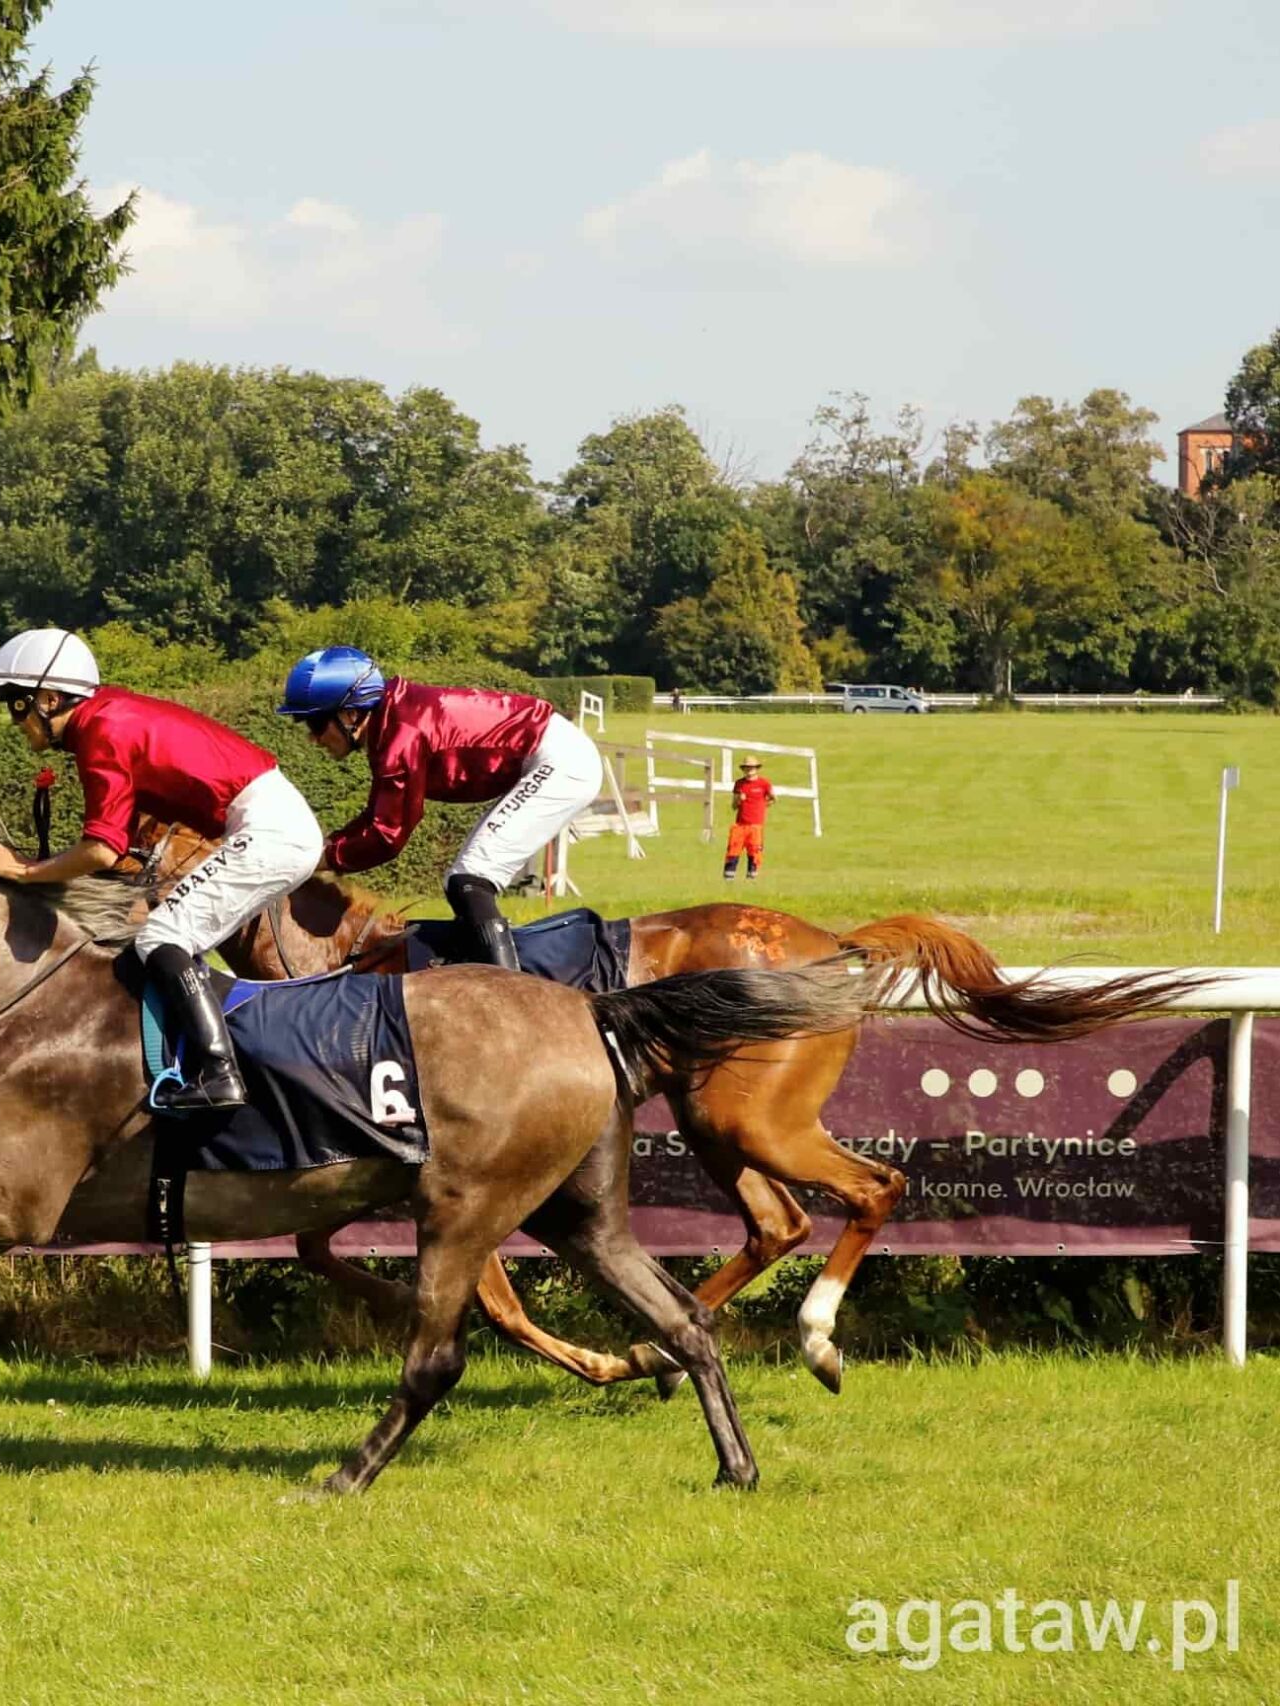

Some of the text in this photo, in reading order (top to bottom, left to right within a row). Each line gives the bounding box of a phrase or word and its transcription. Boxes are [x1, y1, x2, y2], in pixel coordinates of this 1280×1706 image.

[165, 851, 228, 912] ABAEV
[370, 1060, 417, 1125] 6
[966, 1130, 1137, 1163] Partynice
[921, 1178, 1008, 1198] konne.
[1016, 1177, 1135, 1198] Wrocław
